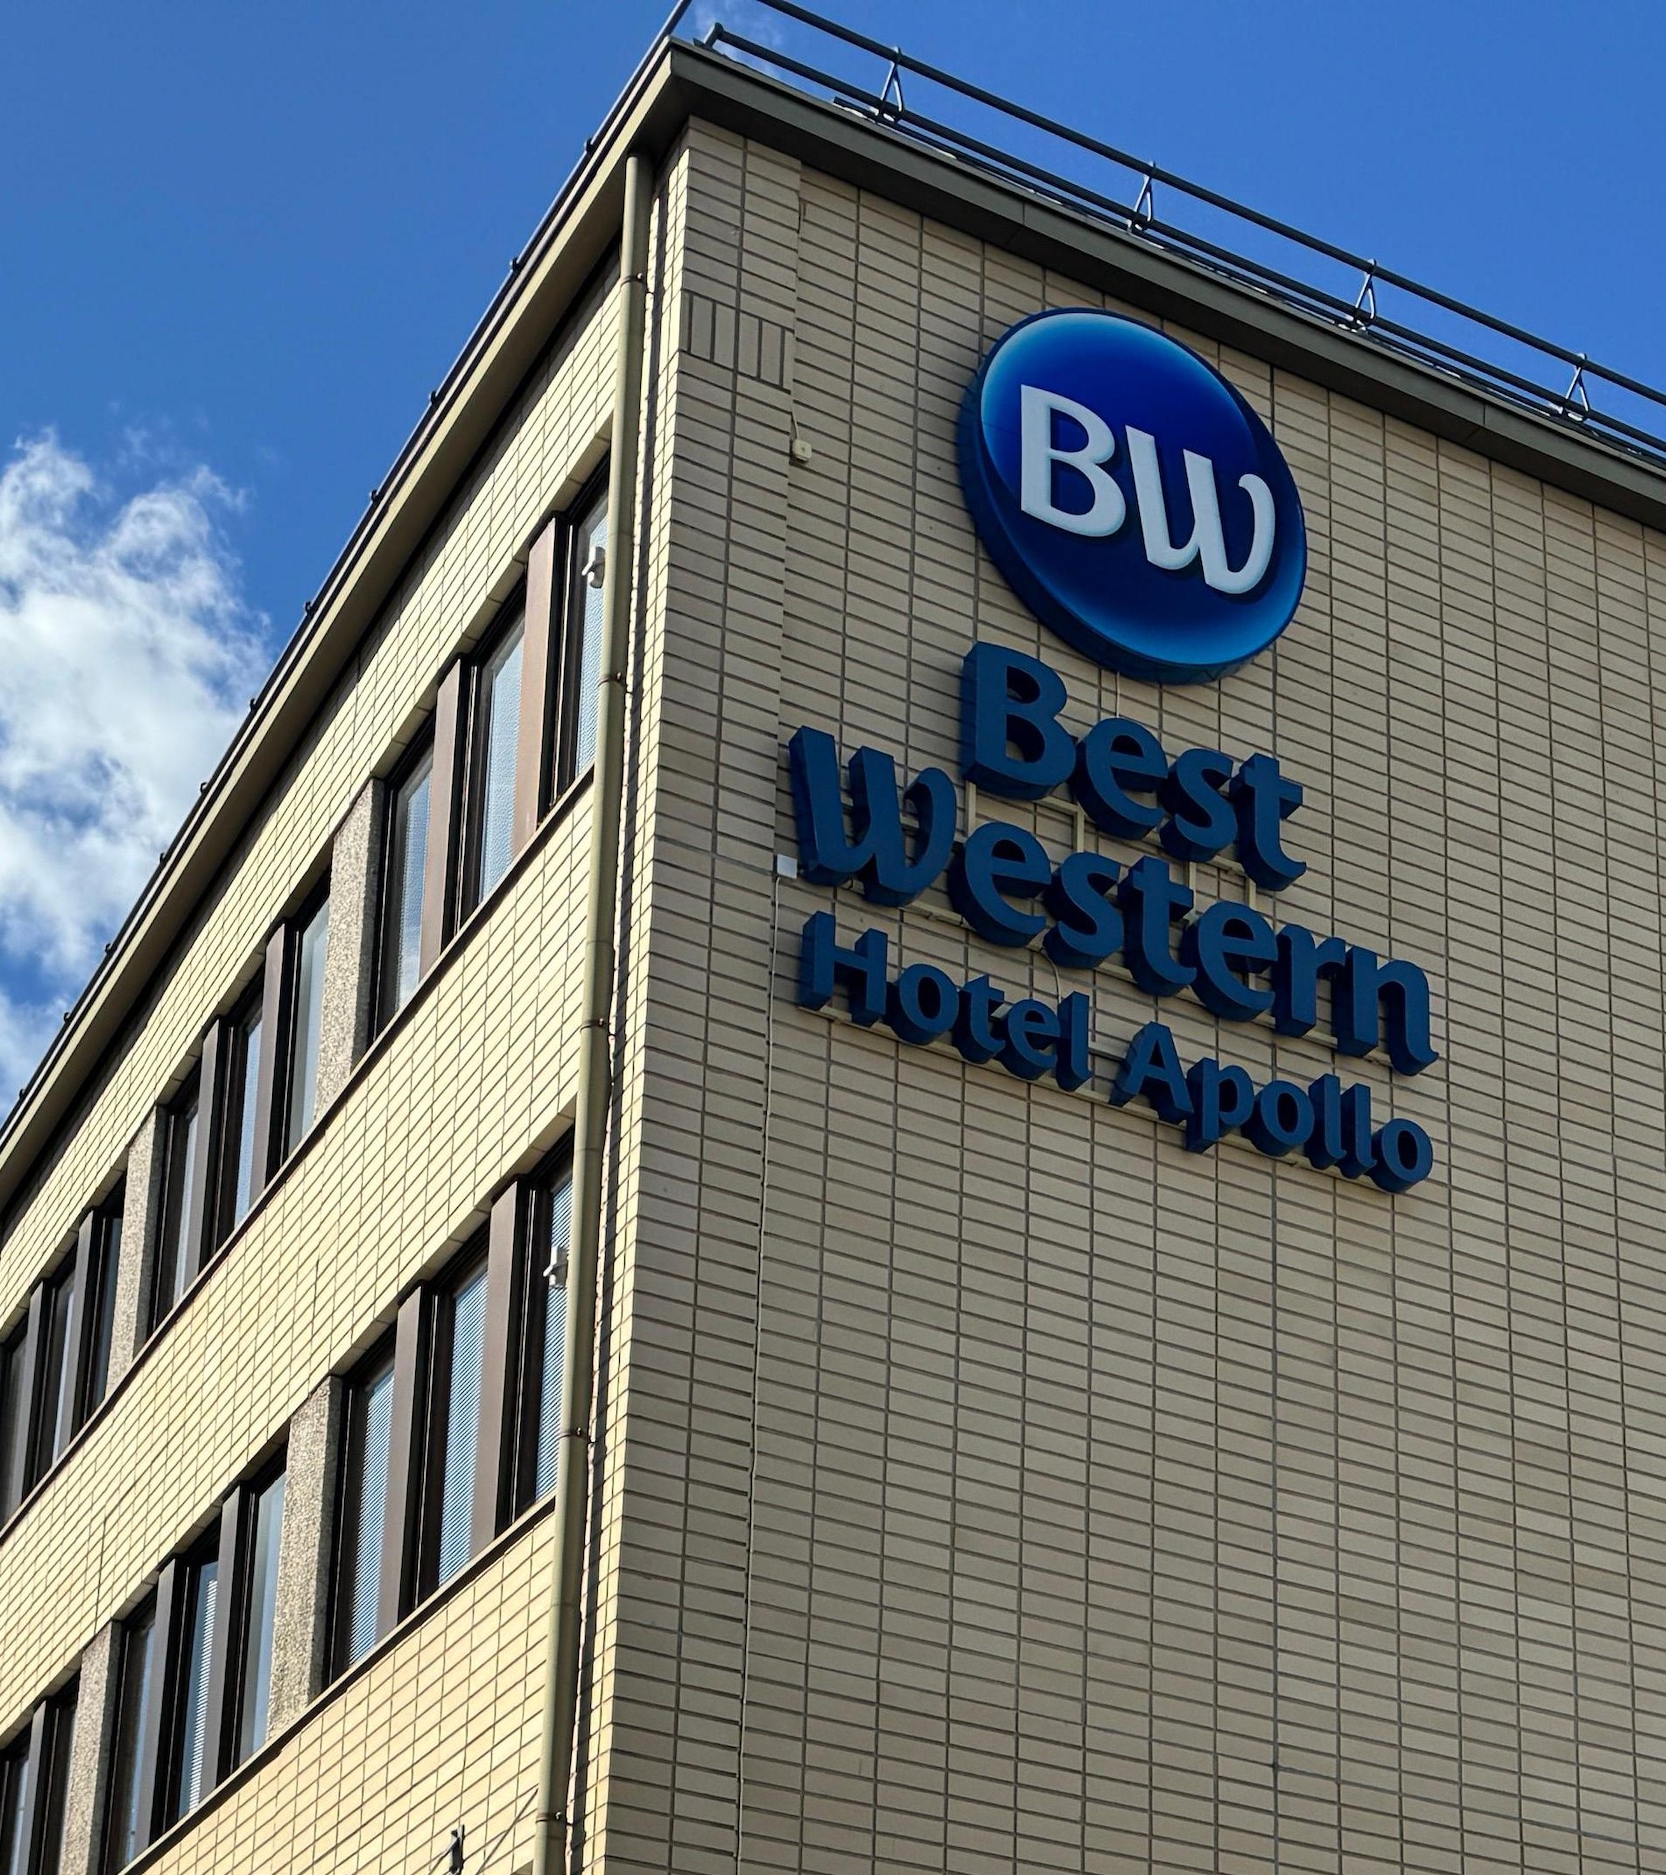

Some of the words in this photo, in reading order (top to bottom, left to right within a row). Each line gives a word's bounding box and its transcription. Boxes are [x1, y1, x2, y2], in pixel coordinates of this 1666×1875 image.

[1019, 383, 1277, 595] BW
[963, 640, 1307, 892] Best
[788, 725, 1440, 1076] Western
[800, 911, 1093, 1092] Hotel
[1110, 1021, 1434, 1194] Apollo
